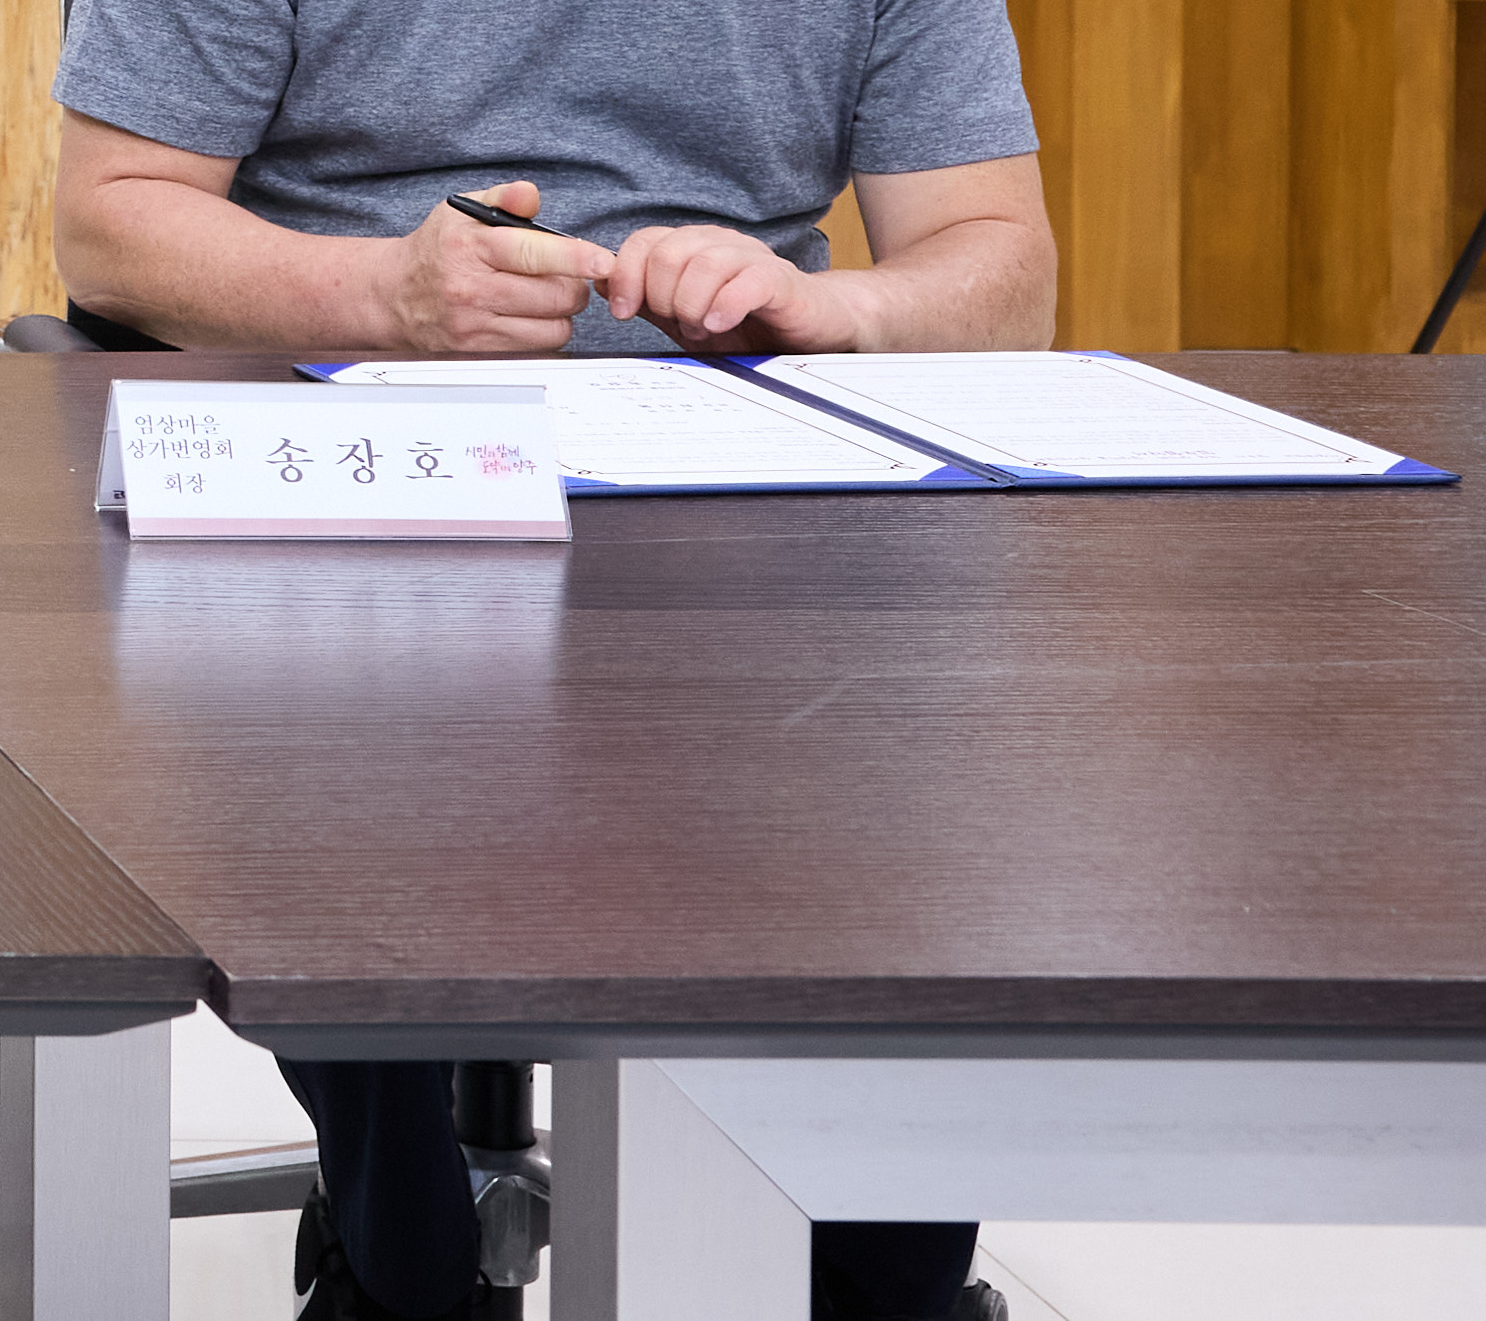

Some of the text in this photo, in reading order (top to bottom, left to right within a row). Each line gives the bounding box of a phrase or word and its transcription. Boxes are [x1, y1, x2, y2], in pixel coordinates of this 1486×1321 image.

[133, 413, 223, 436] 엄상마을
[126, 437, 235, 461] 상가번영회
[163, 472, 208, 495] 회장
